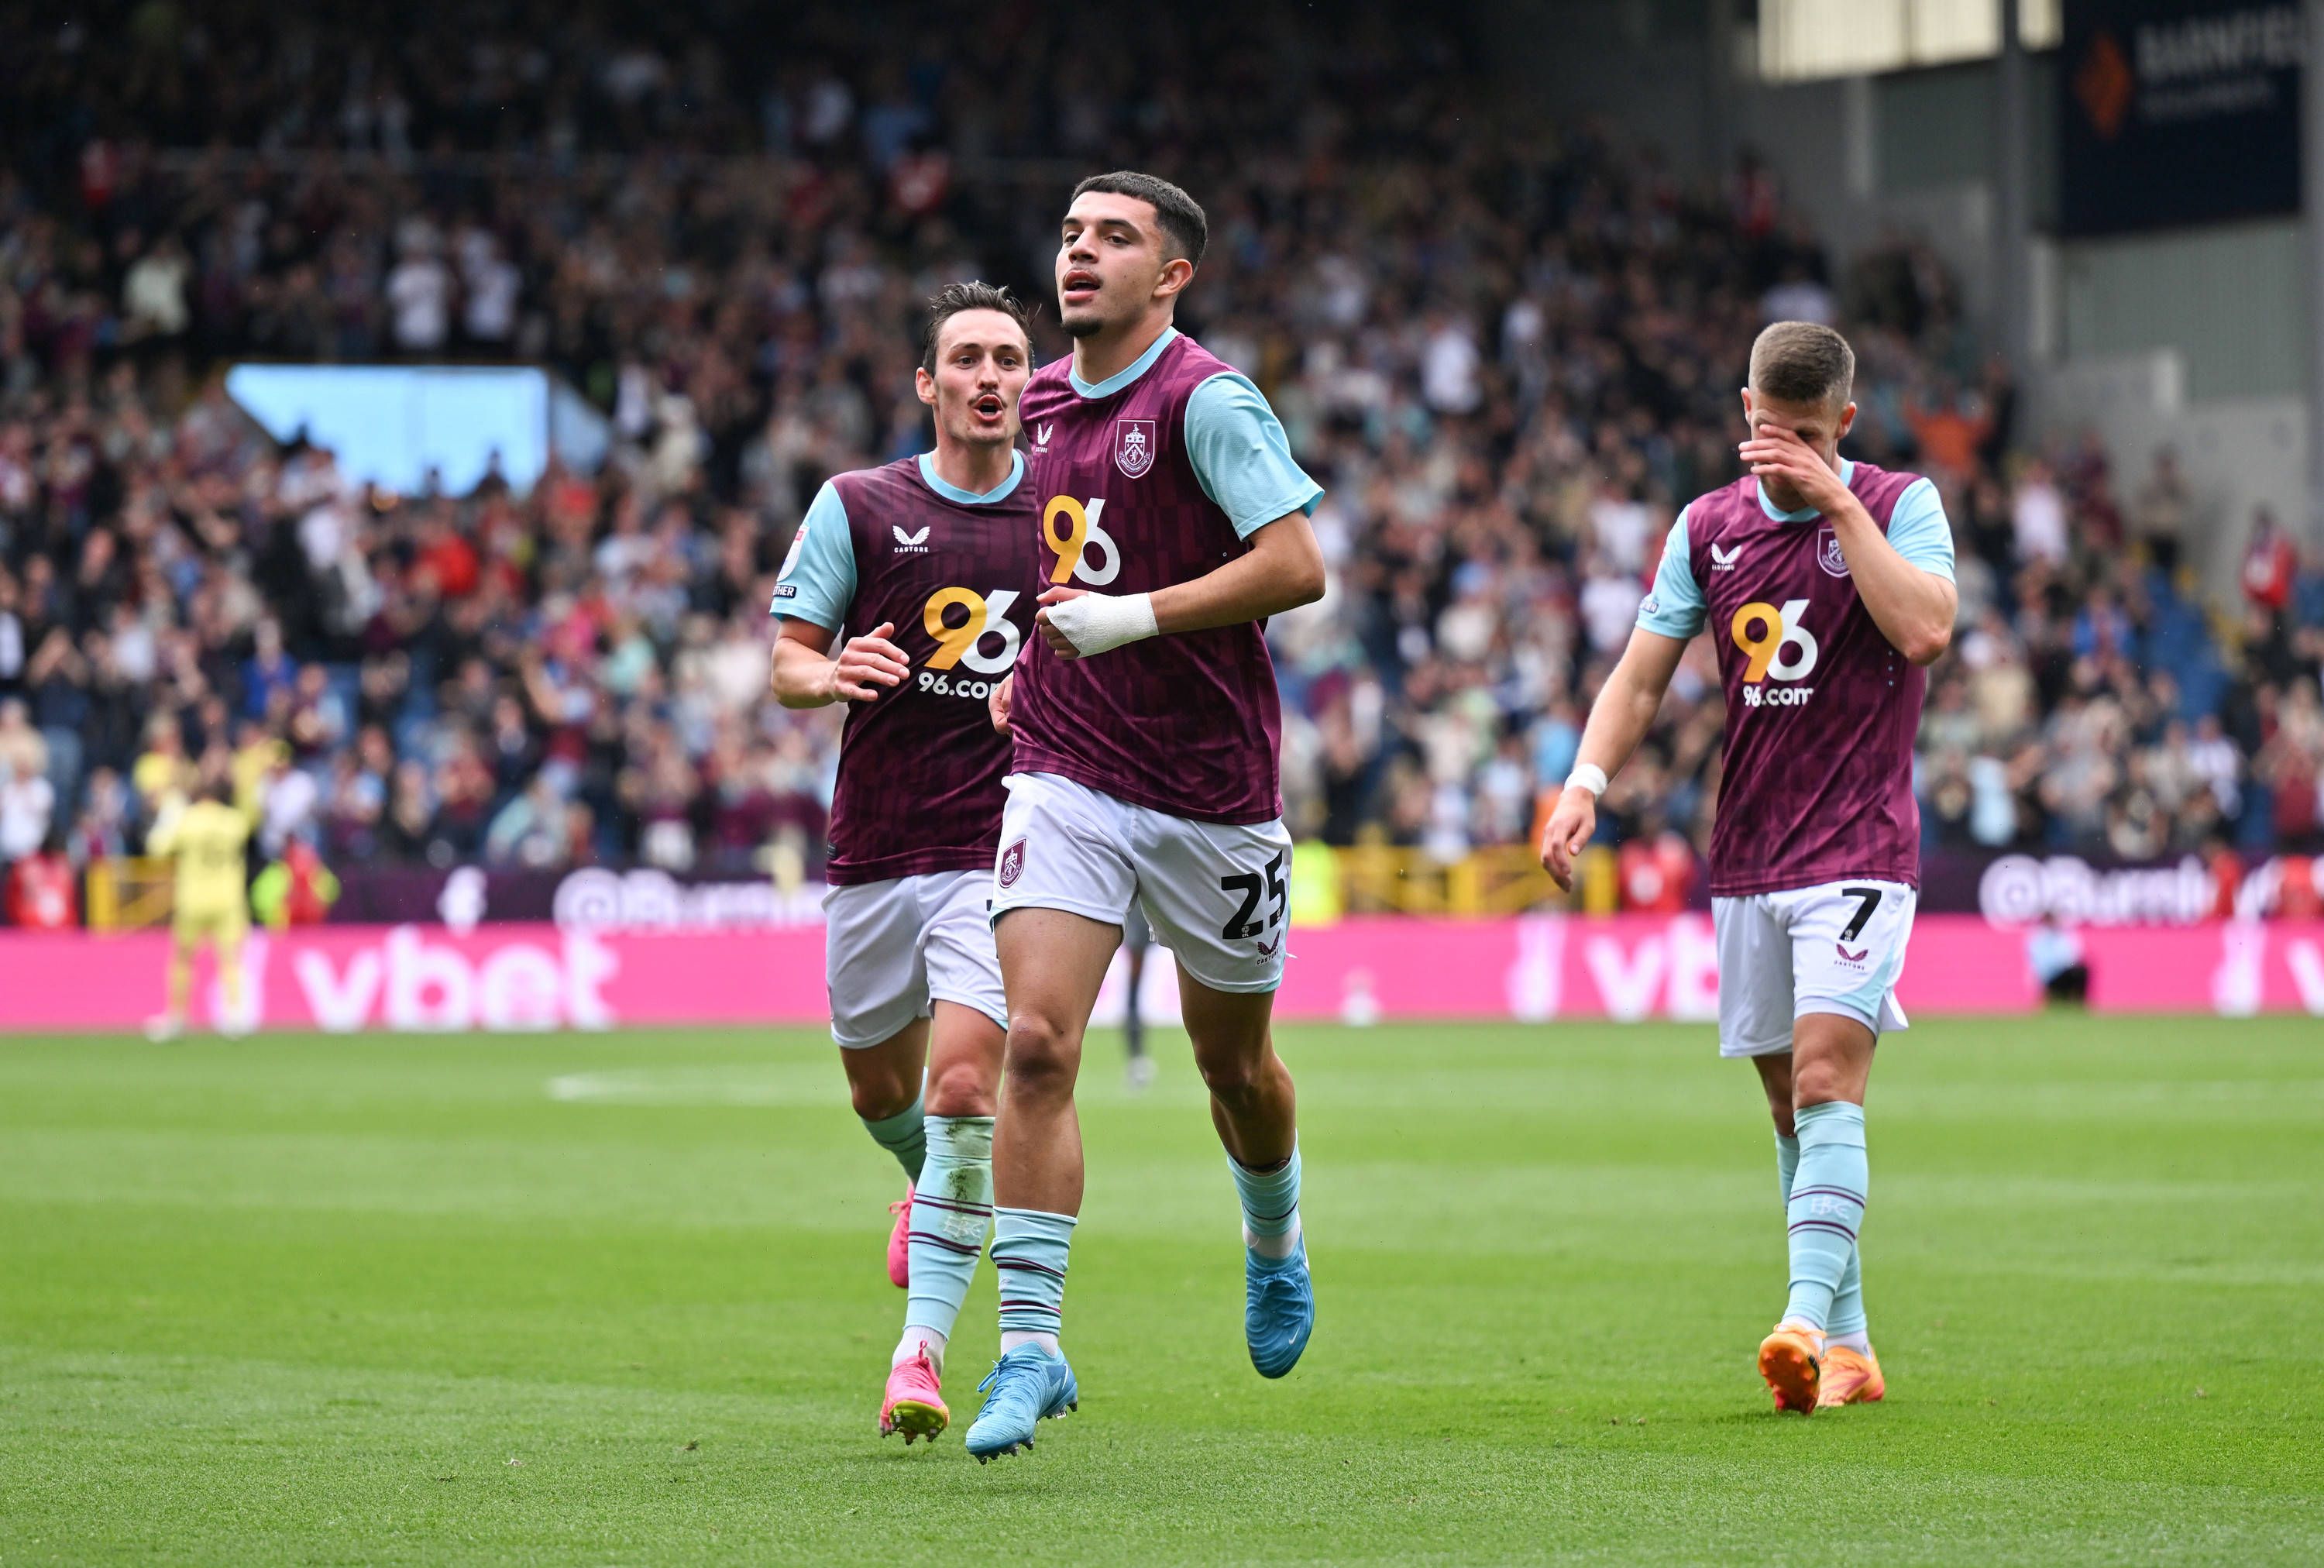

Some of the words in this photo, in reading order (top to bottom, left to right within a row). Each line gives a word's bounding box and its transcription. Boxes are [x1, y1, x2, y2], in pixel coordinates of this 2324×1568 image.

[1043, 494, 1121, 585] 96
[923, 586, 1021, 674] 96
[1731, 598, 1818, 683] 96
[1743, 685, 1813, 707] 96.com
[1221, 849, 1286, 940] 25
[1839, 888, 1882, 942] 7
[294, 923, 618, 1033] vbet
